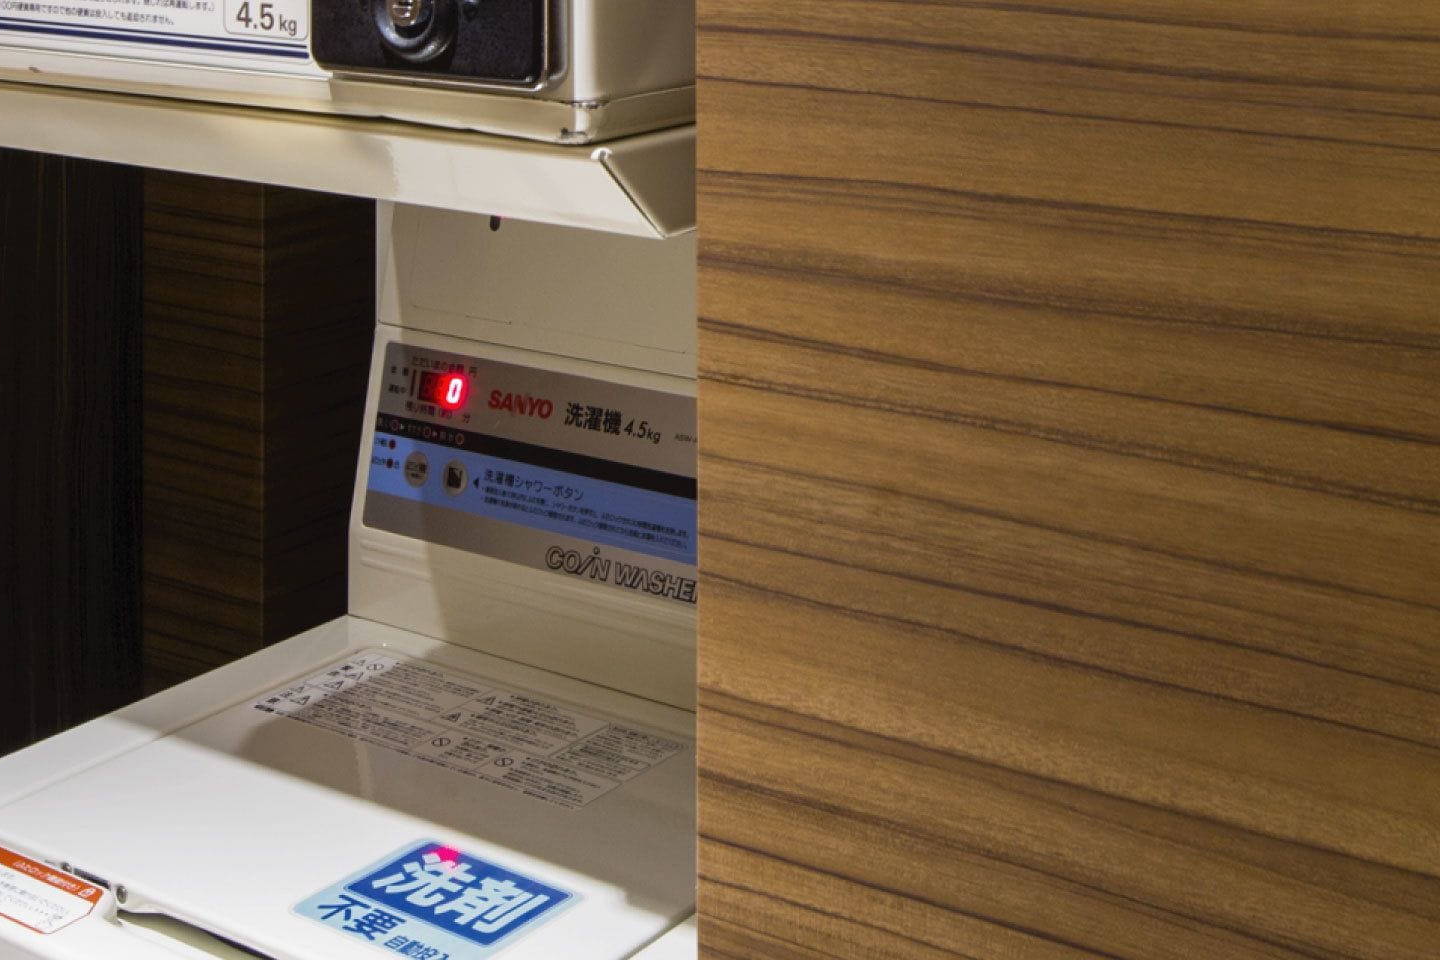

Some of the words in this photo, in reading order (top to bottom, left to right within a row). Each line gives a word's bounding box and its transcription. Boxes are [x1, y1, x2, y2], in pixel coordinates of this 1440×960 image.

[446, 377, 464, 404] 0
[488, 390, 554, 420] SANYO
[564, 402, 622, 436] 洗濯機
[623, 418, 662, 445] 4.5kg
[544, 544, 612, 583] COIN
[371, 851, 551, 934] 洗剤
[317, 894, 406, 941] 不要
